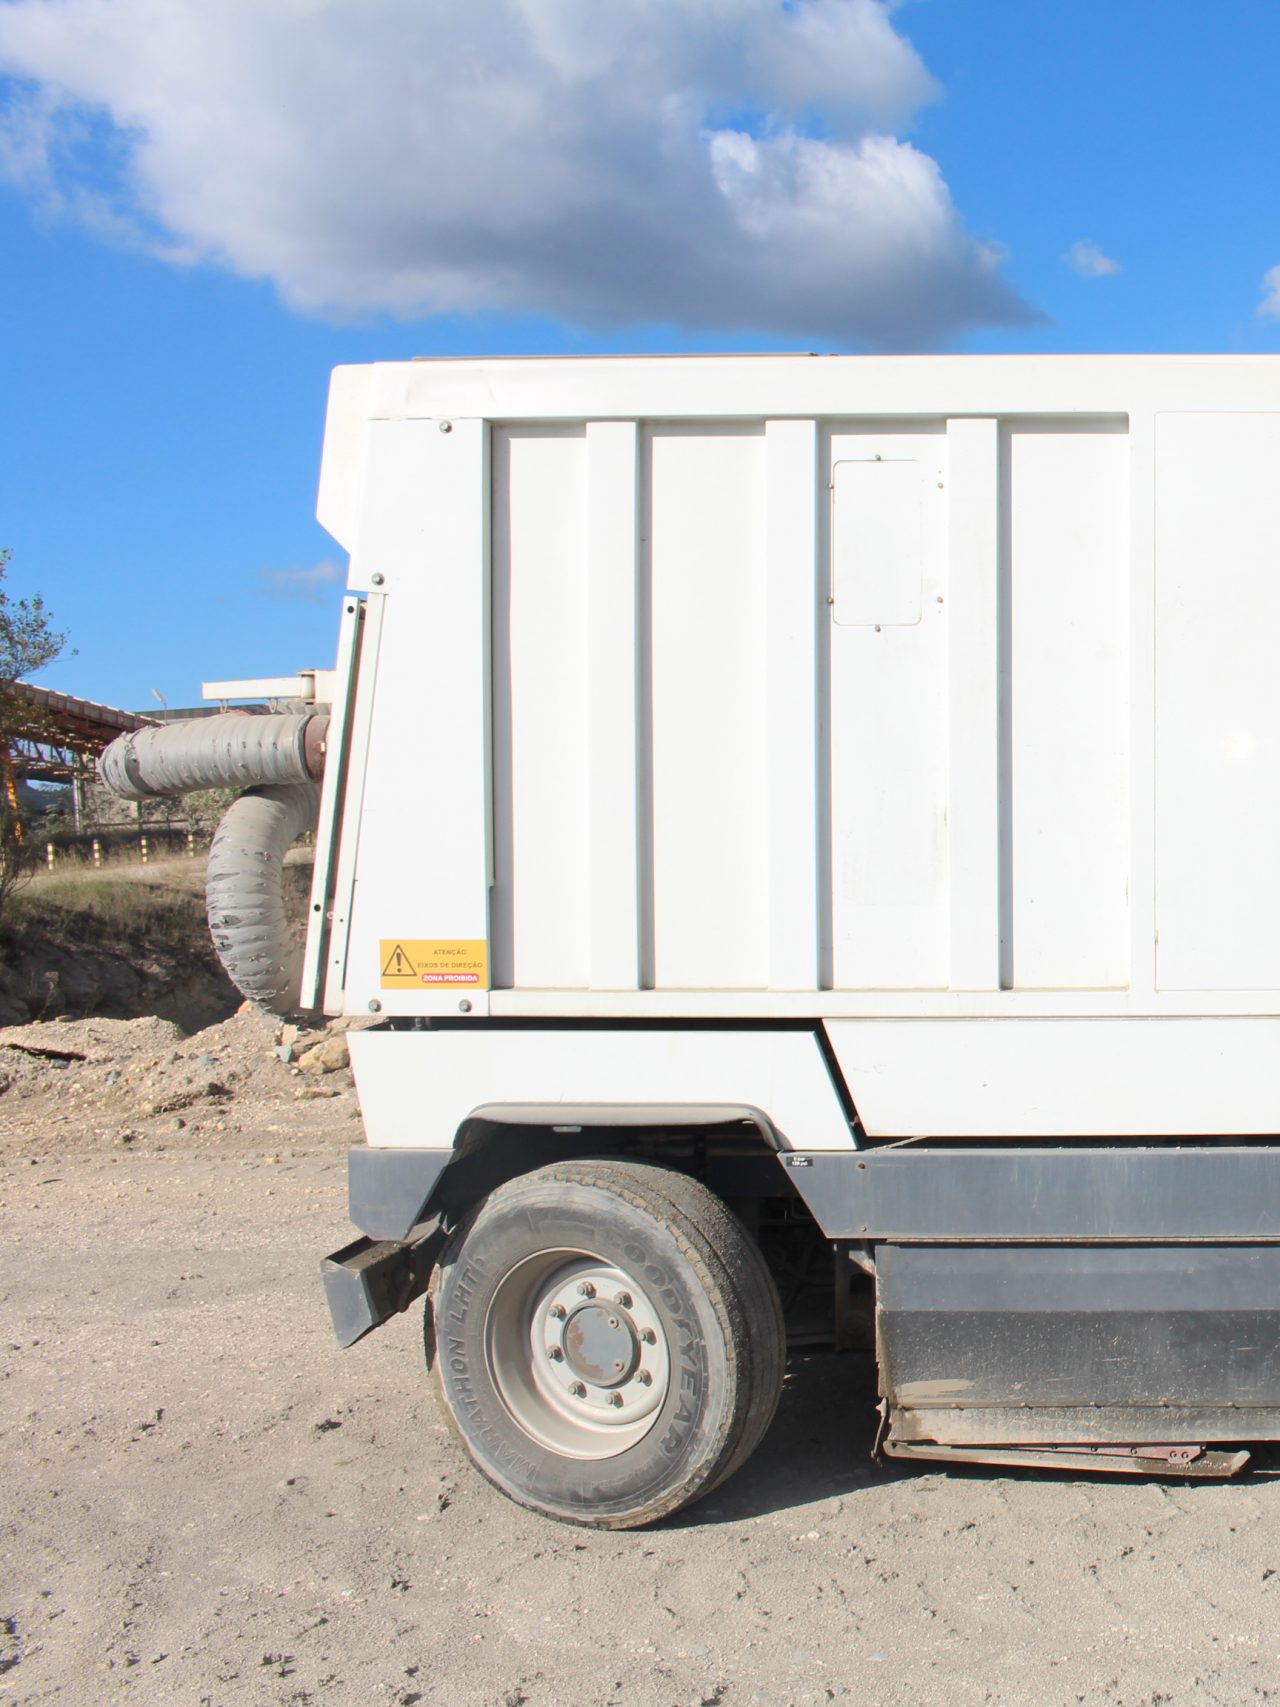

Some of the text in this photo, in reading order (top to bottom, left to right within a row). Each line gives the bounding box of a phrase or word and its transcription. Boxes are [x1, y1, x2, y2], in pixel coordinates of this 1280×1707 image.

[433, 948, 467, 957] ATENÇÃO
[451, 960, 483, 970] DIREÇÃO
[448, 1336, 537, 1488] MARATHON
